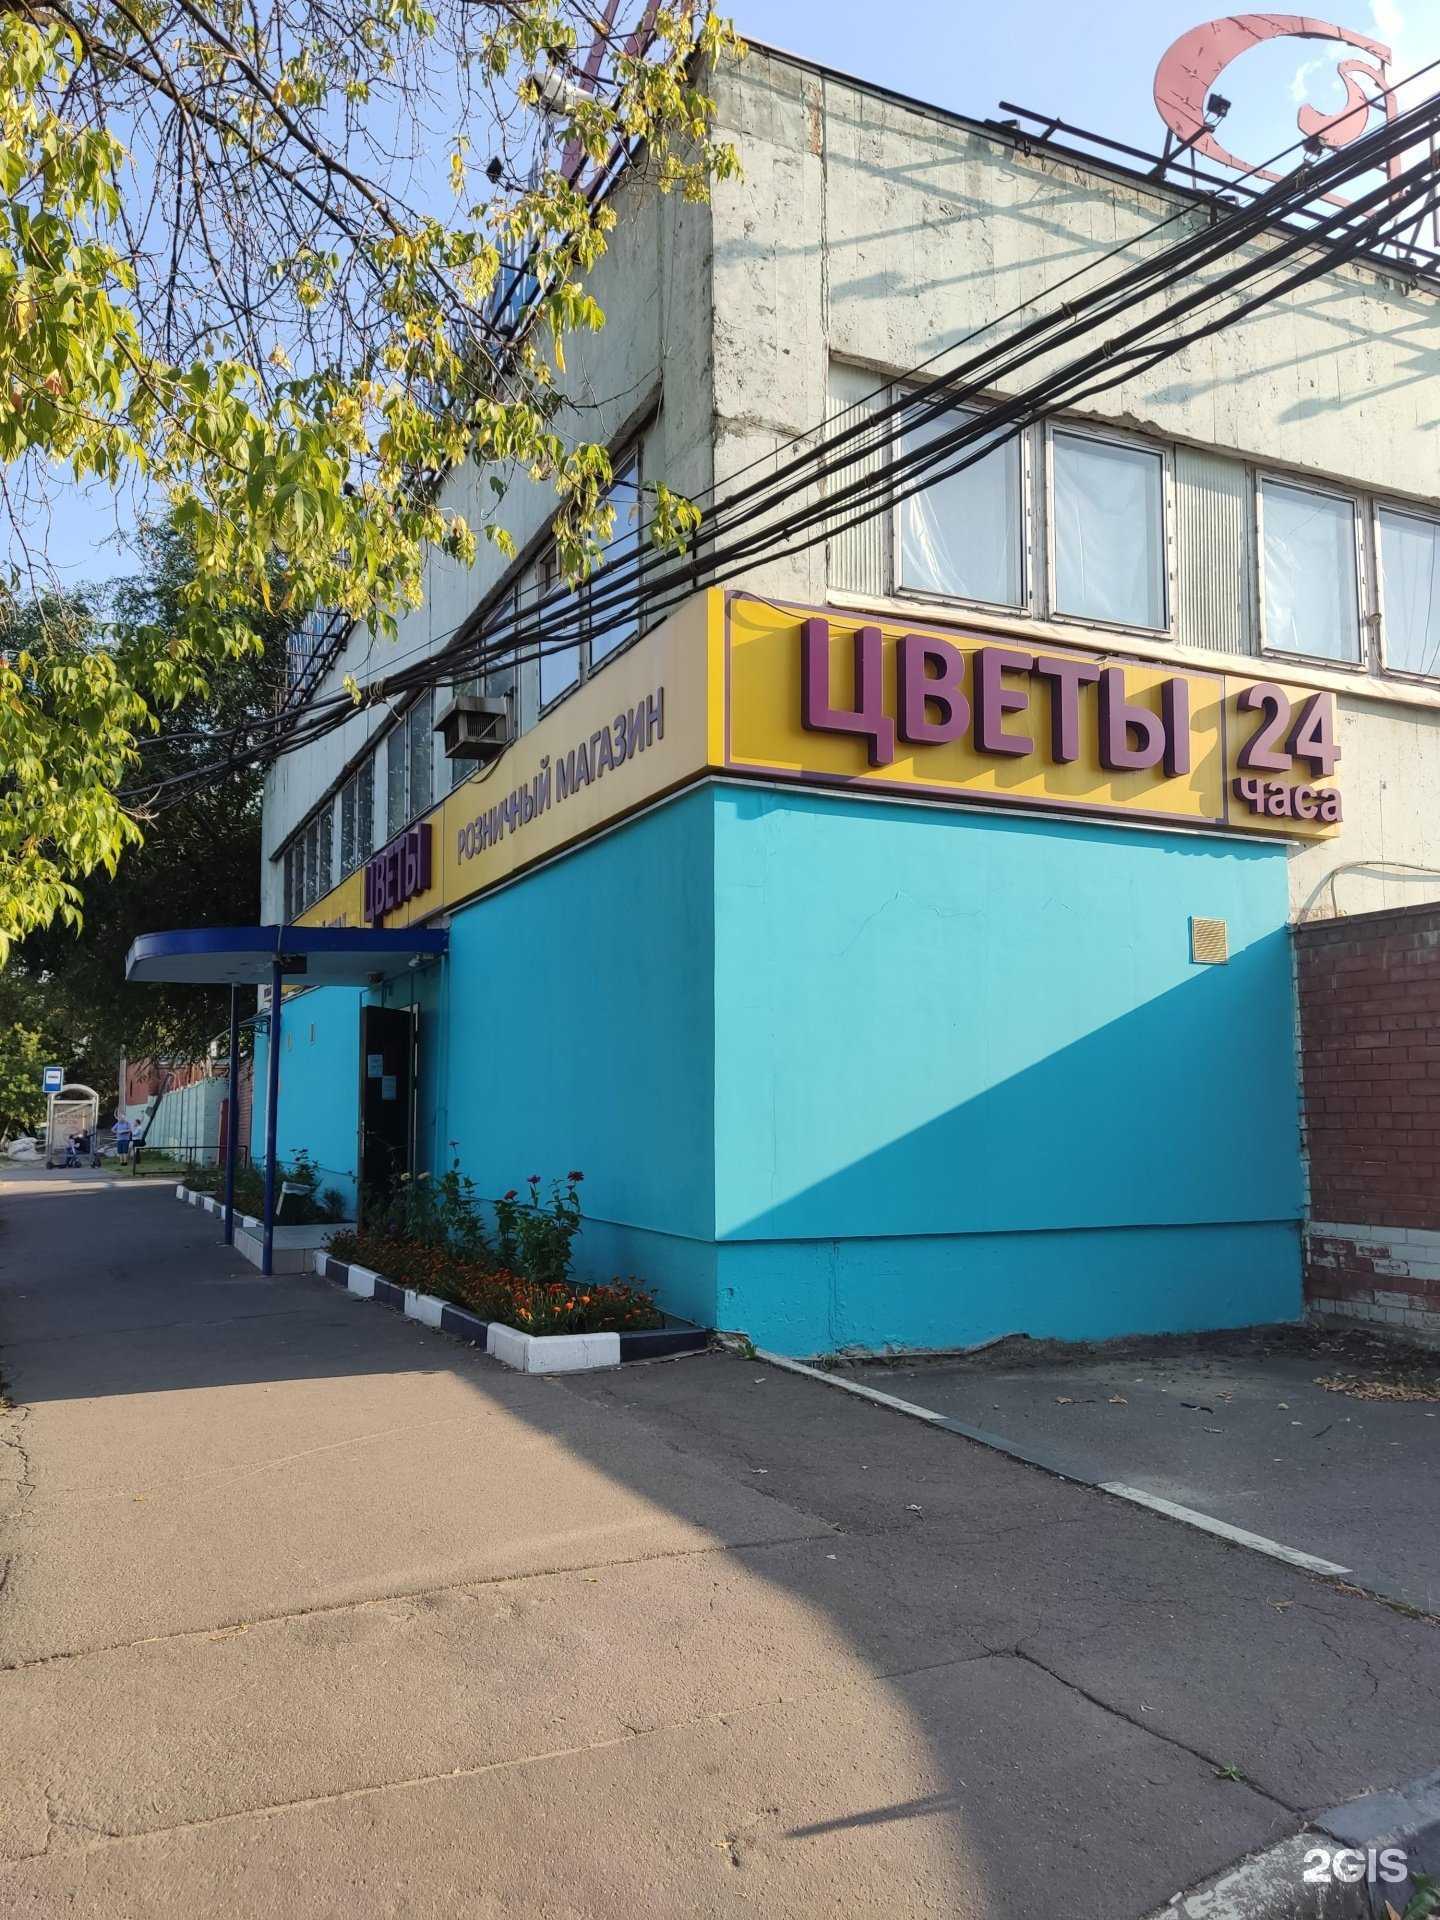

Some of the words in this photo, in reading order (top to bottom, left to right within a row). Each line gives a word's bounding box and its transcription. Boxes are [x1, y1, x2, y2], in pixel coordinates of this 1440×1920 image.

[802, 618, 1190, 777] ЦВЕТЫ
[1238, 683, 1341, 777] 24
[457, 755, 551, 866] РОЗНИЧНЫЙ
[556, 687, 664, 803] МАГАЗИН
[1232, 776, 1344, 823] часа
[364, 821, 432, 927] ЦВЕТЫ
